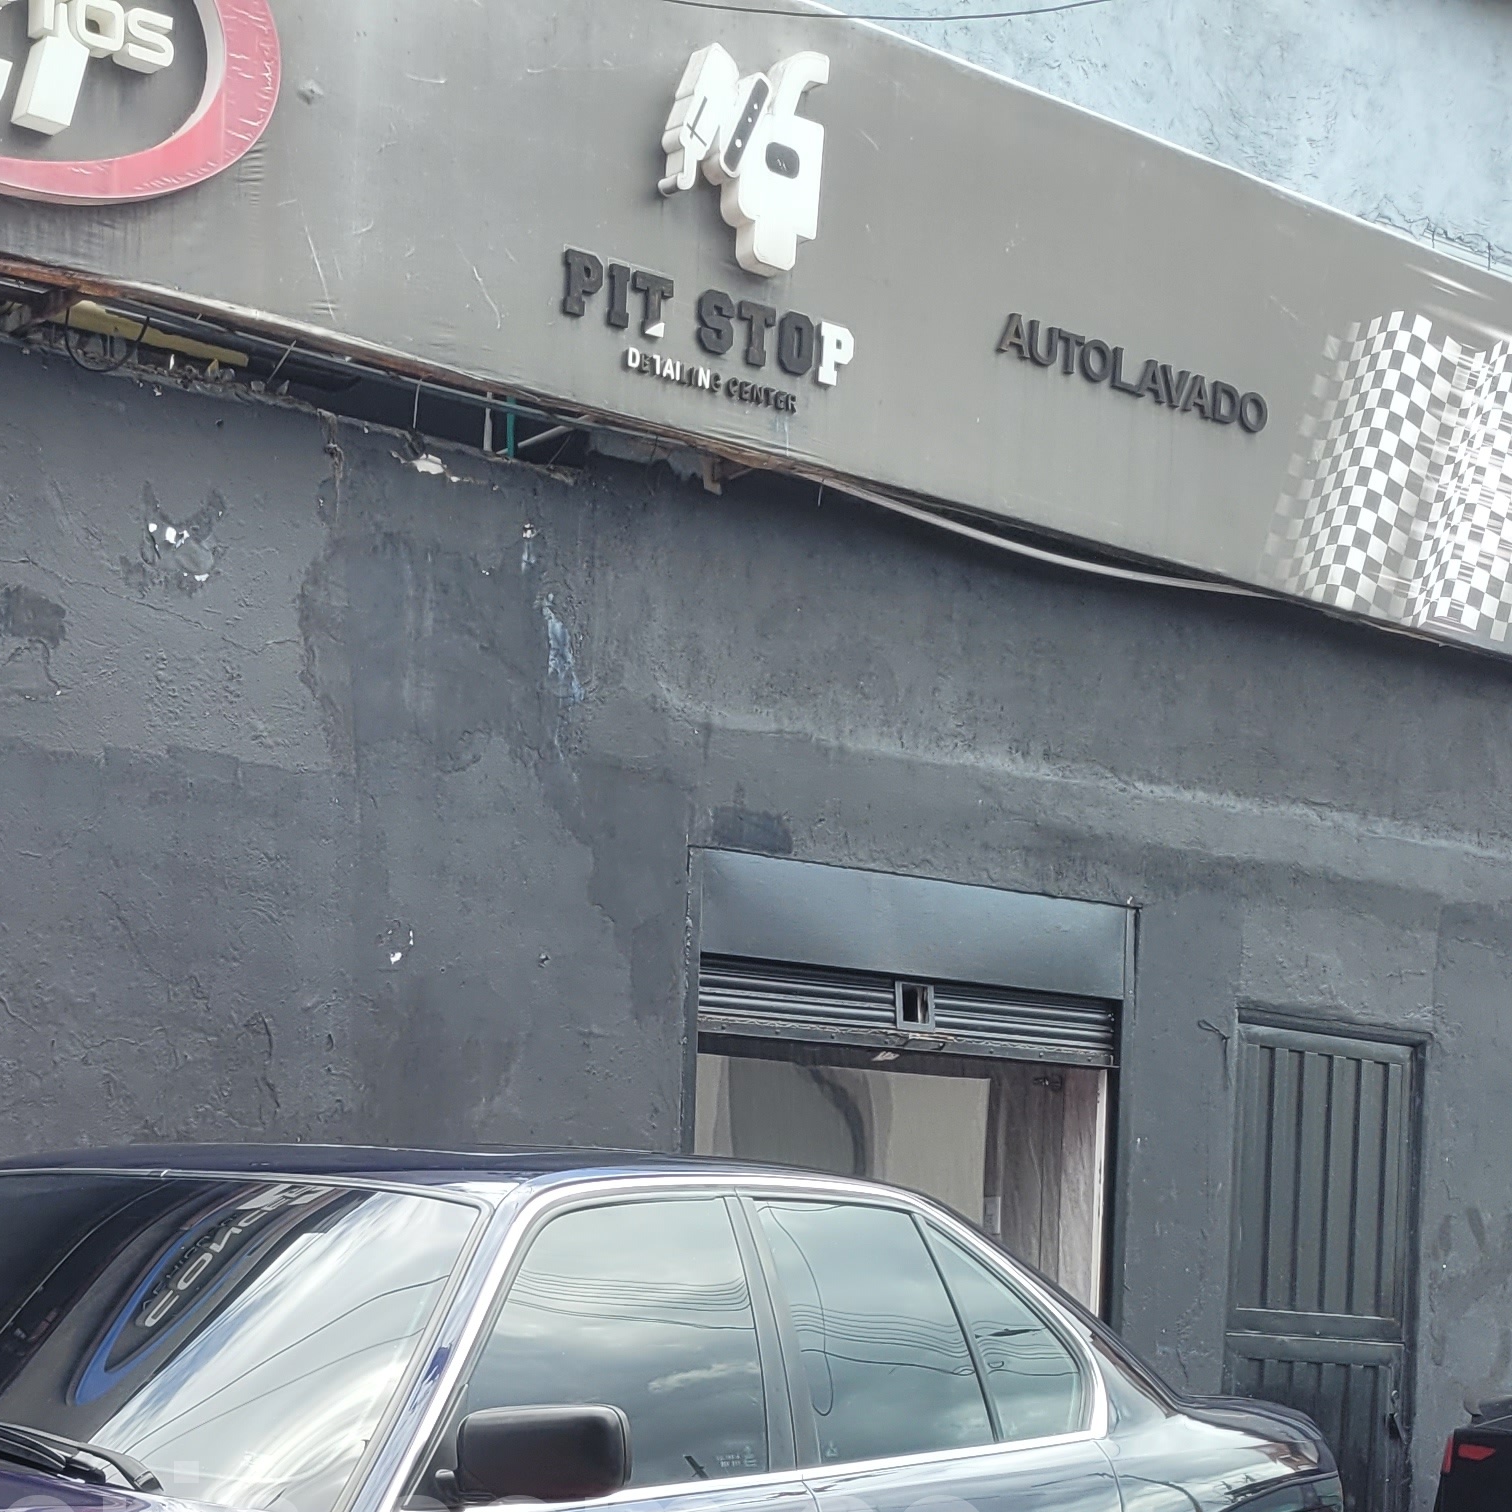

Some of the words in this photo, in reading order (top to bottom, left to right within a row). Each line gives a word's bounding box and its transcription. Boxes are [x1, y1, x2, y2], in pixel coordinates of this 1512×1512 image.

[561, 246, 675, 339] PIT
[697, 288, 855, 387] STOP
[996, 312, 1269, 433] AUTOLAVADO
